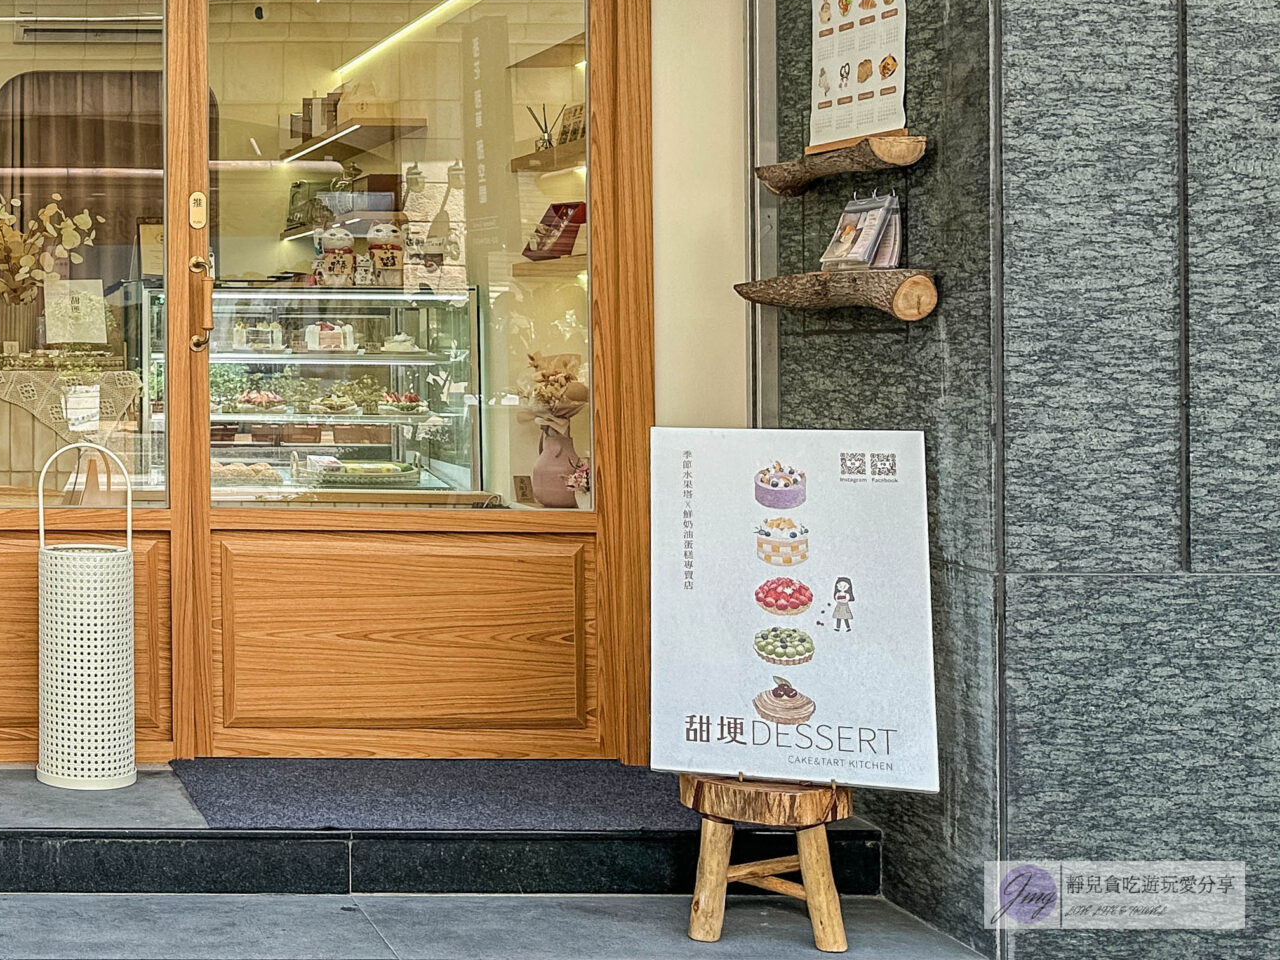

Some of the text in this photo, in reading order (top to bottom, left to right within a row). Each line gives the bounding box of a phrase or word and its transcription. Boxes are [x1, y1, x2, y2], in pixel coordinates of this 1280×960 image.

[192, 198, 202, 208] 推
[684, 714, 898, 755] 甜埂 DESSERT
[787, 755, 894, 771] CAKE&TART KITCHEN
